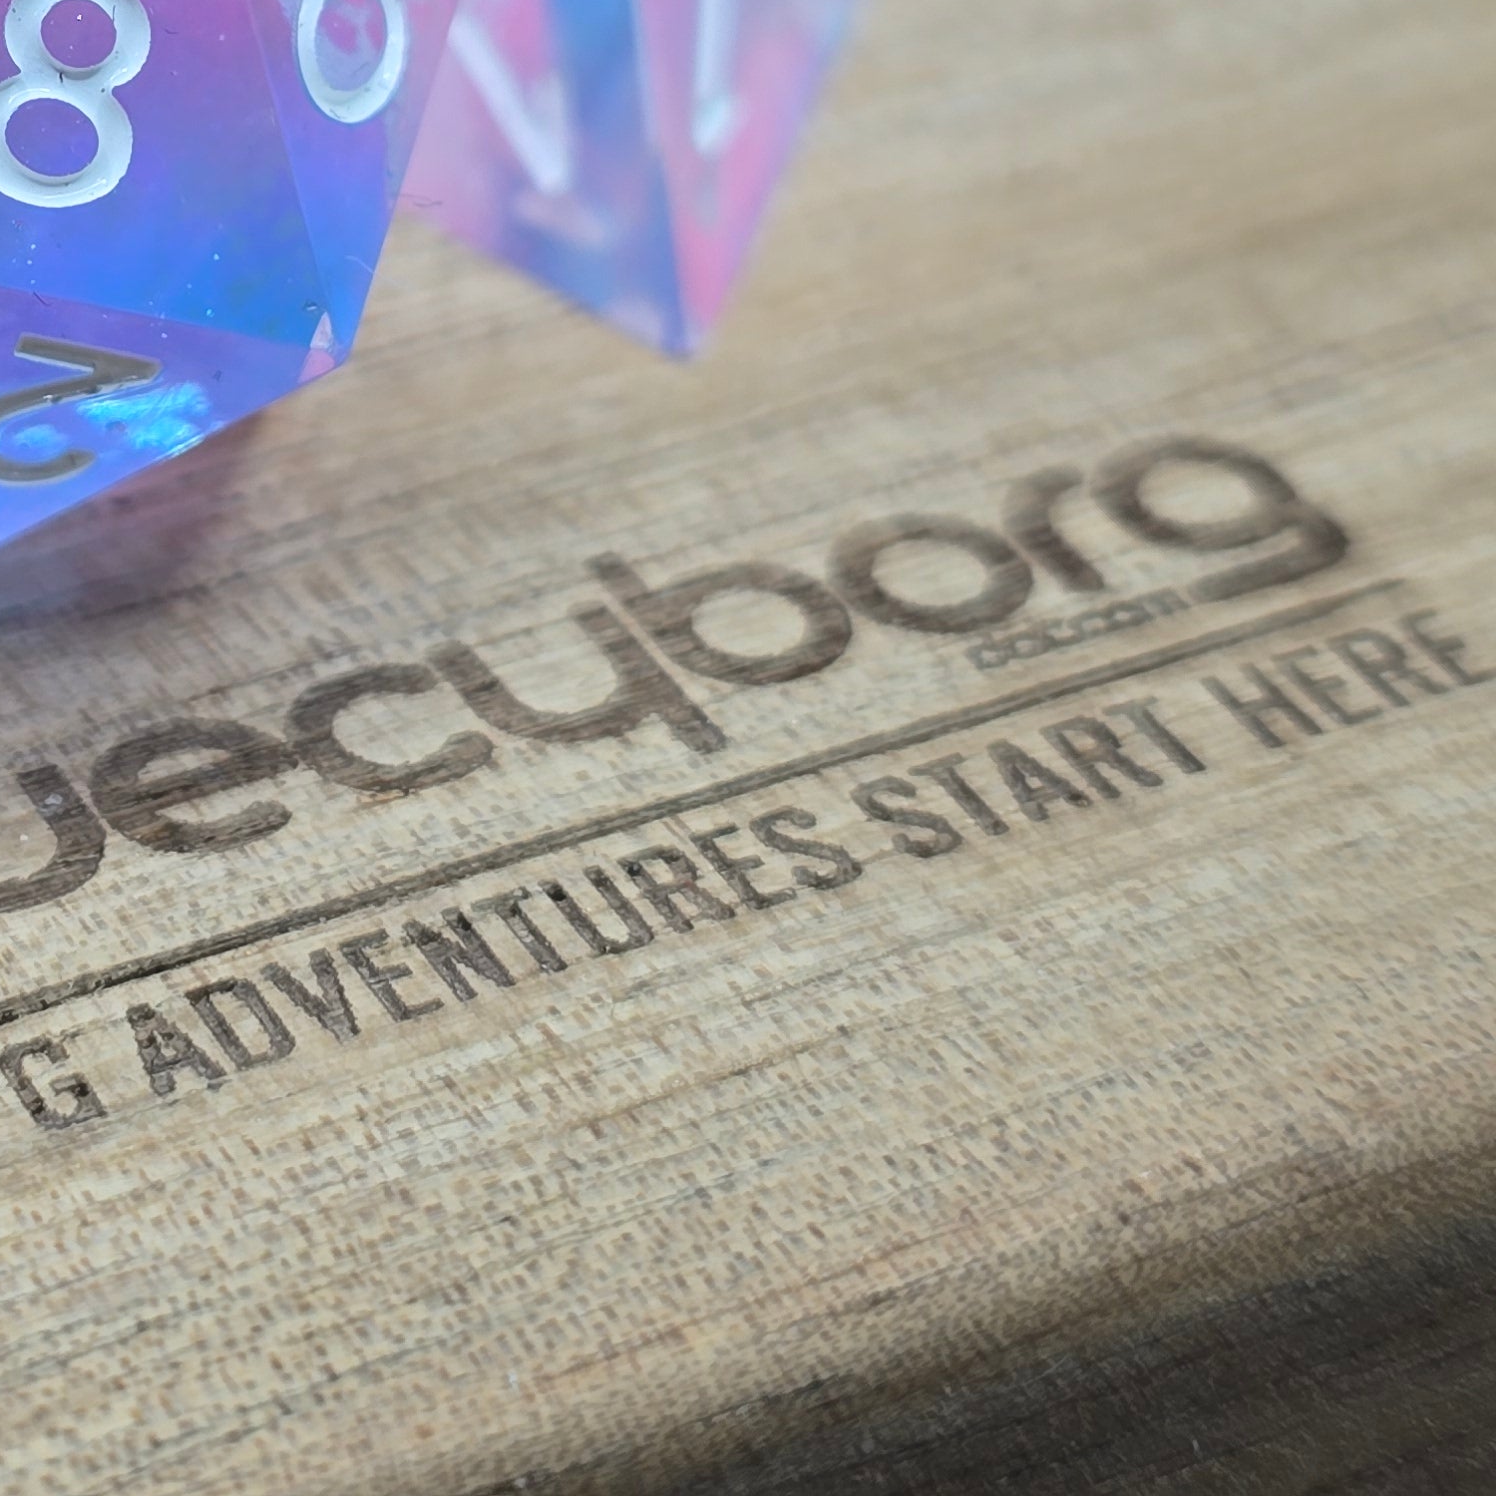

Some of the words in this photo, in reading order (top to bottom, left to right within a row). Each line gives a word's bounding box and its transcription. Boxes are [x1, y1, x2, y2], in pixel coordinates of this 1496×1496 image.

[126, 807, 864, 1096] ADVENTURES
[849, 694, 1208, 859] START
[1210, 608, 1496, 748] HERE
